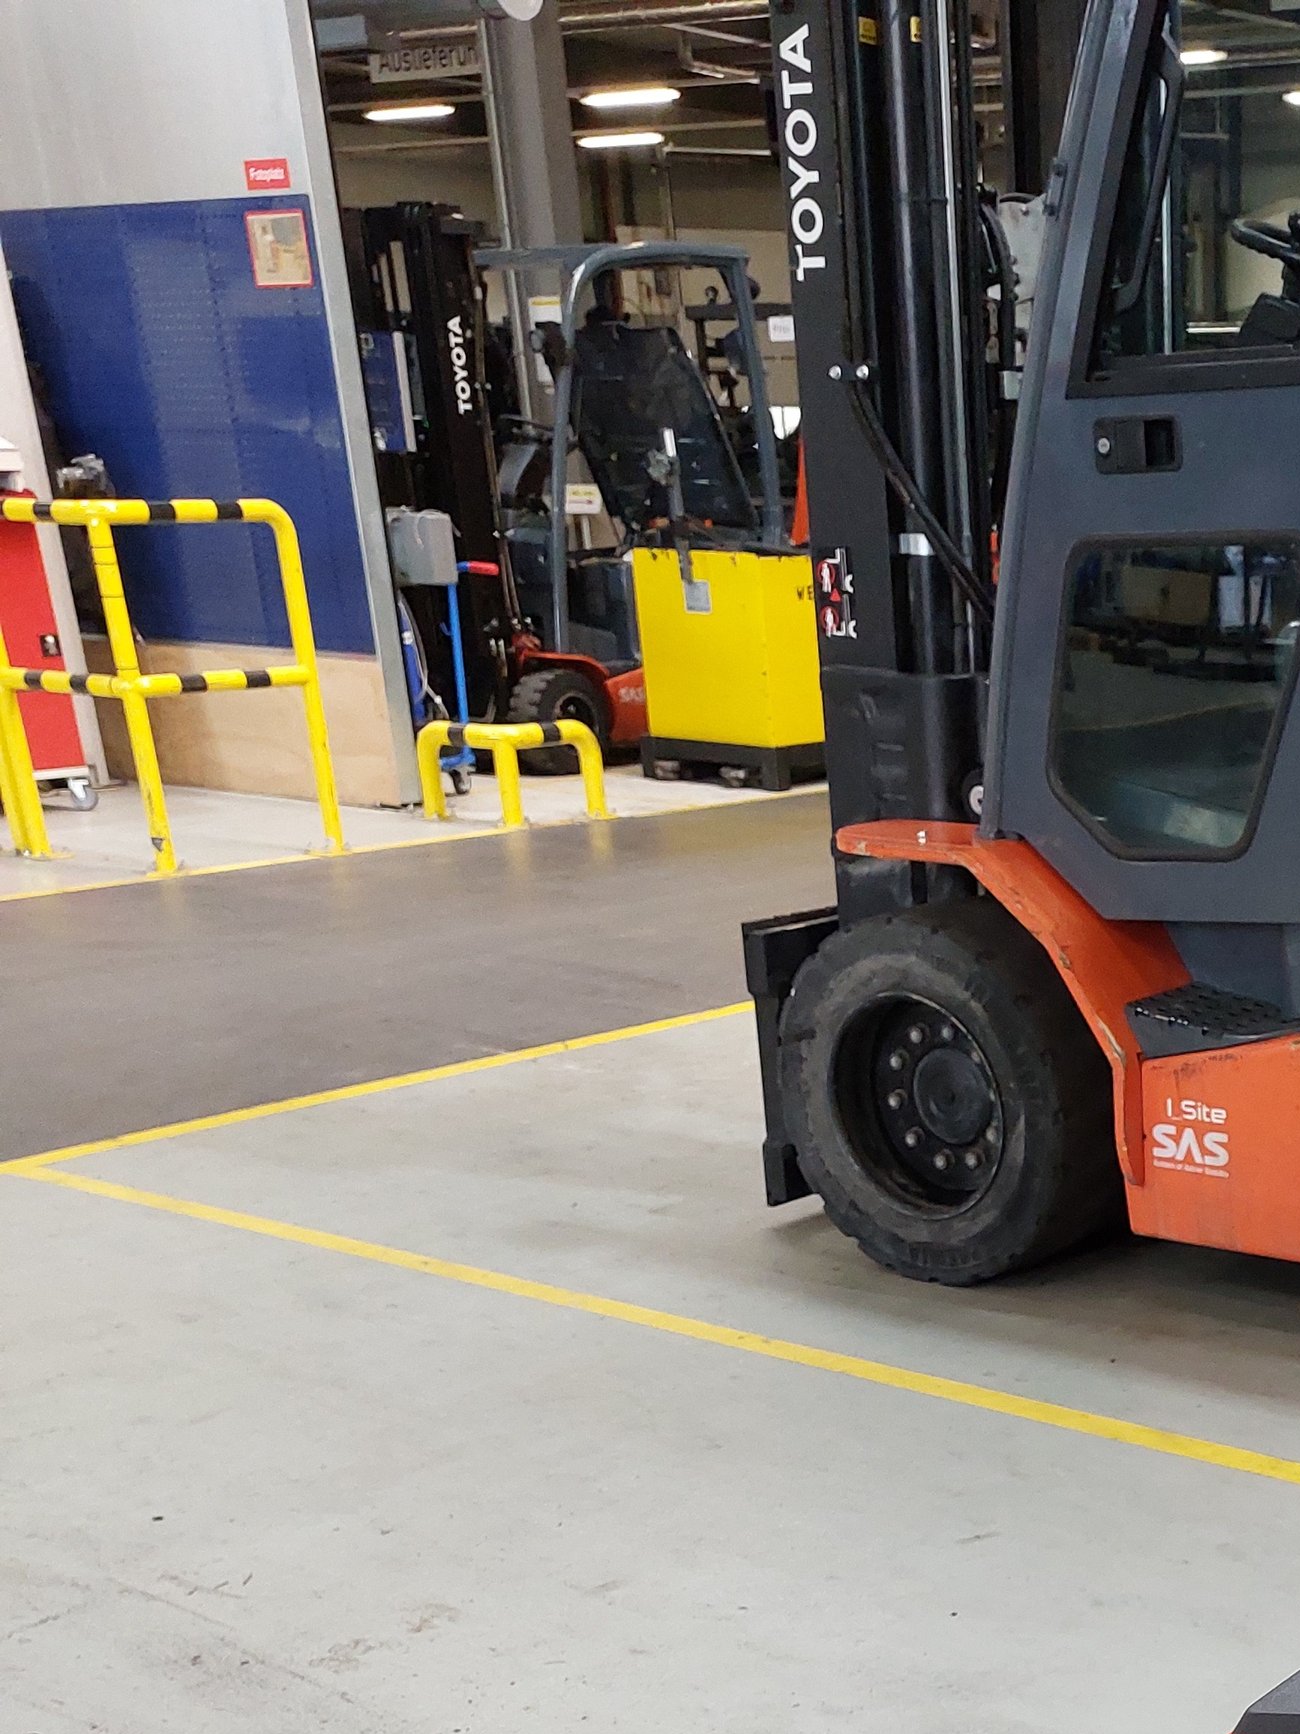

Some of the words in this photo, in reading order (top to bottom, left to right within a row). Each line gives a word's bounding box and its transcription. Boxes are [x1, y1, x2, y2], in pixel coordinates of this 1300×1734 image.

[379, 46, 477, 72] Auslieferun
[779, 23, 826, 281] TOYOTA
[447, 315, 473, 415] TOYOTA
[1152, 1123, 1229, 1167] SAS
